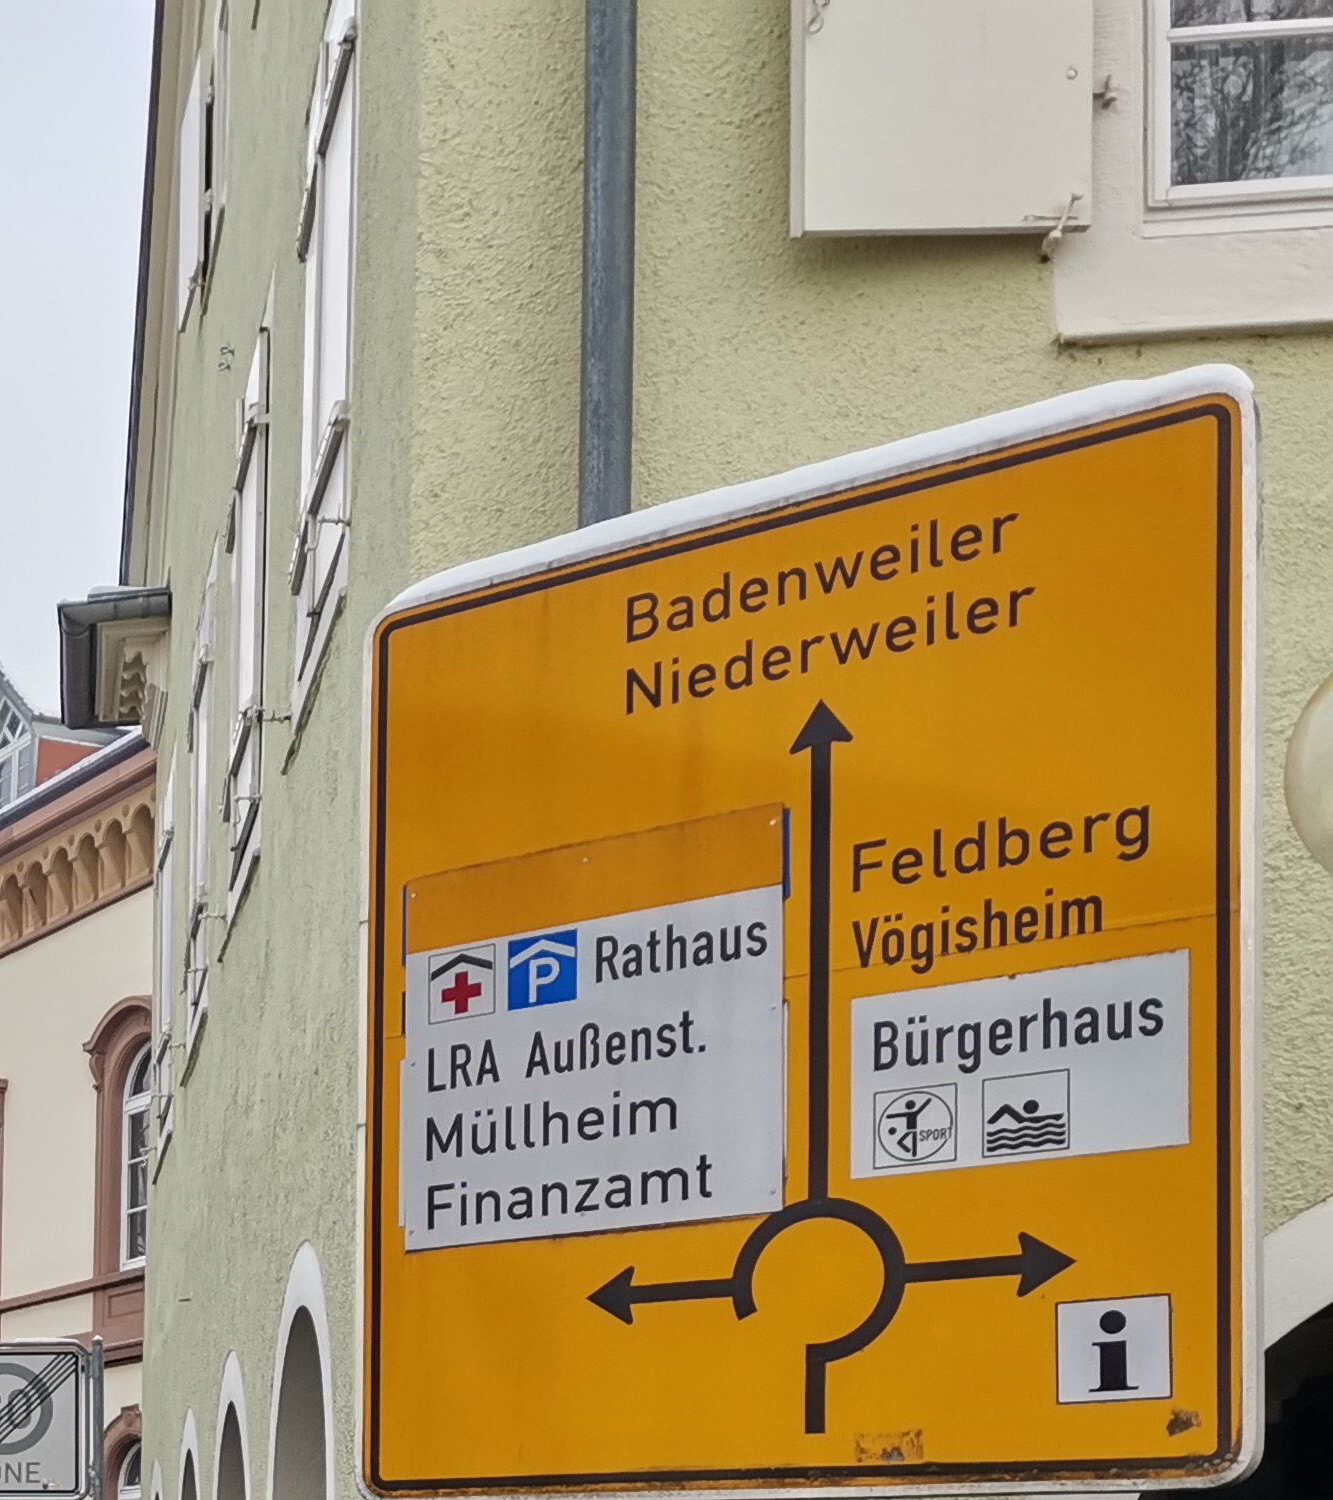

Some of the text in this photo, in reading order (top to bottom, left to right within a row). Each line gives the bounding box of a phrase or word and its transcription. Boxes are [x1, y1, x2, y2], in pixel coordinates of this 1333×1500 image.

[626, 513, 1019, 643] Badenweiler
[626, 586, 1036, 715] Niederweiler
[852, 804, 1150, 893] Feldberg
[528, 921, 768, 1004] P Rathaus
[852, 888, 1103, 974] Vögisheim
[427, 1010, 707, 1093] LRA Außenst.
[873, 997, 1164, 1074] Bürgerhaus
[426, 1090, 678, 1161] Müllheim
[919, 1126, 953, 1142] SPORT
[426, 1154, 713, 1230] Finanzamt
[1088, 1309, 1139, 1393] i
